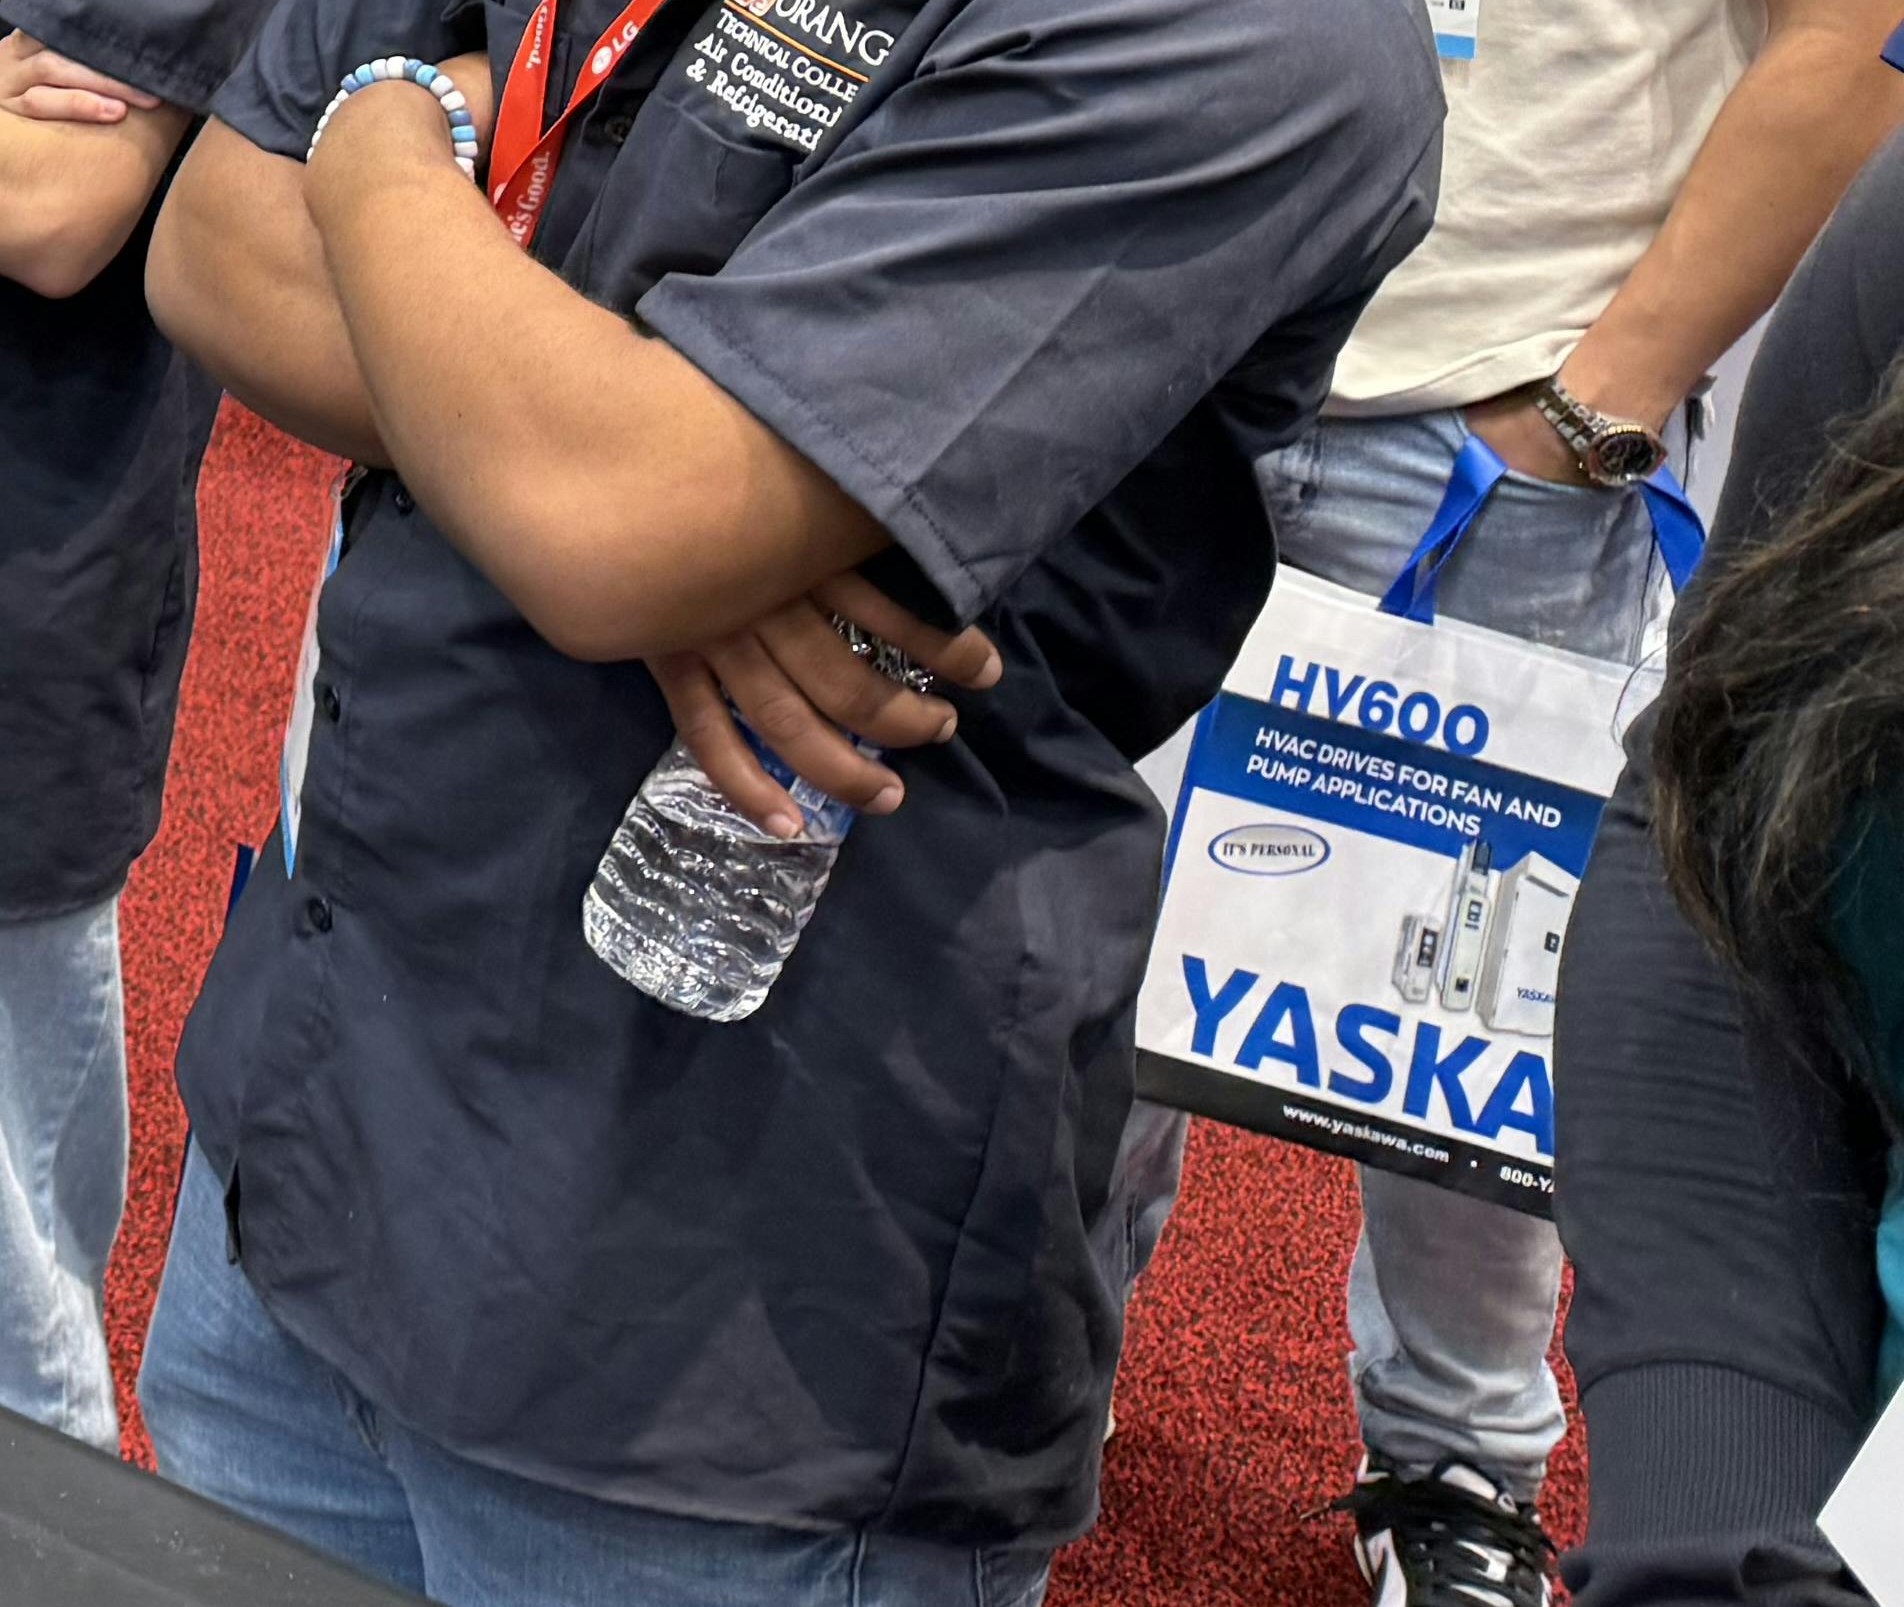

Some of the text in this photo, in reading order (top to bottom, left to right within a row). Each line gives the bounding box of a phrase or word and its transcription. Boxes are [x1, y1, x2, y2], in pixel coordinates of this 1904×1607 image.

[612, 20, 640, 53] LG
[685, 57, 708, 83] &
[693, 32, 728, 64] Air
[715, 7, 860, 104] TECHNICAL COLLE
[1268, 654, 1491, 757] HV600
[1245, 752, 1482, 837] PUMP APPLICATIONS
[1255, 725, 1562, 830] HVAC DRIVES FOR FAN AND
[1222, 841, 1317, 858] IT'S PERSONAL
[1181, 953, 1555, 1158] YASKA
[1282, 1103, 1451, 1164] www.yaskawa.com
